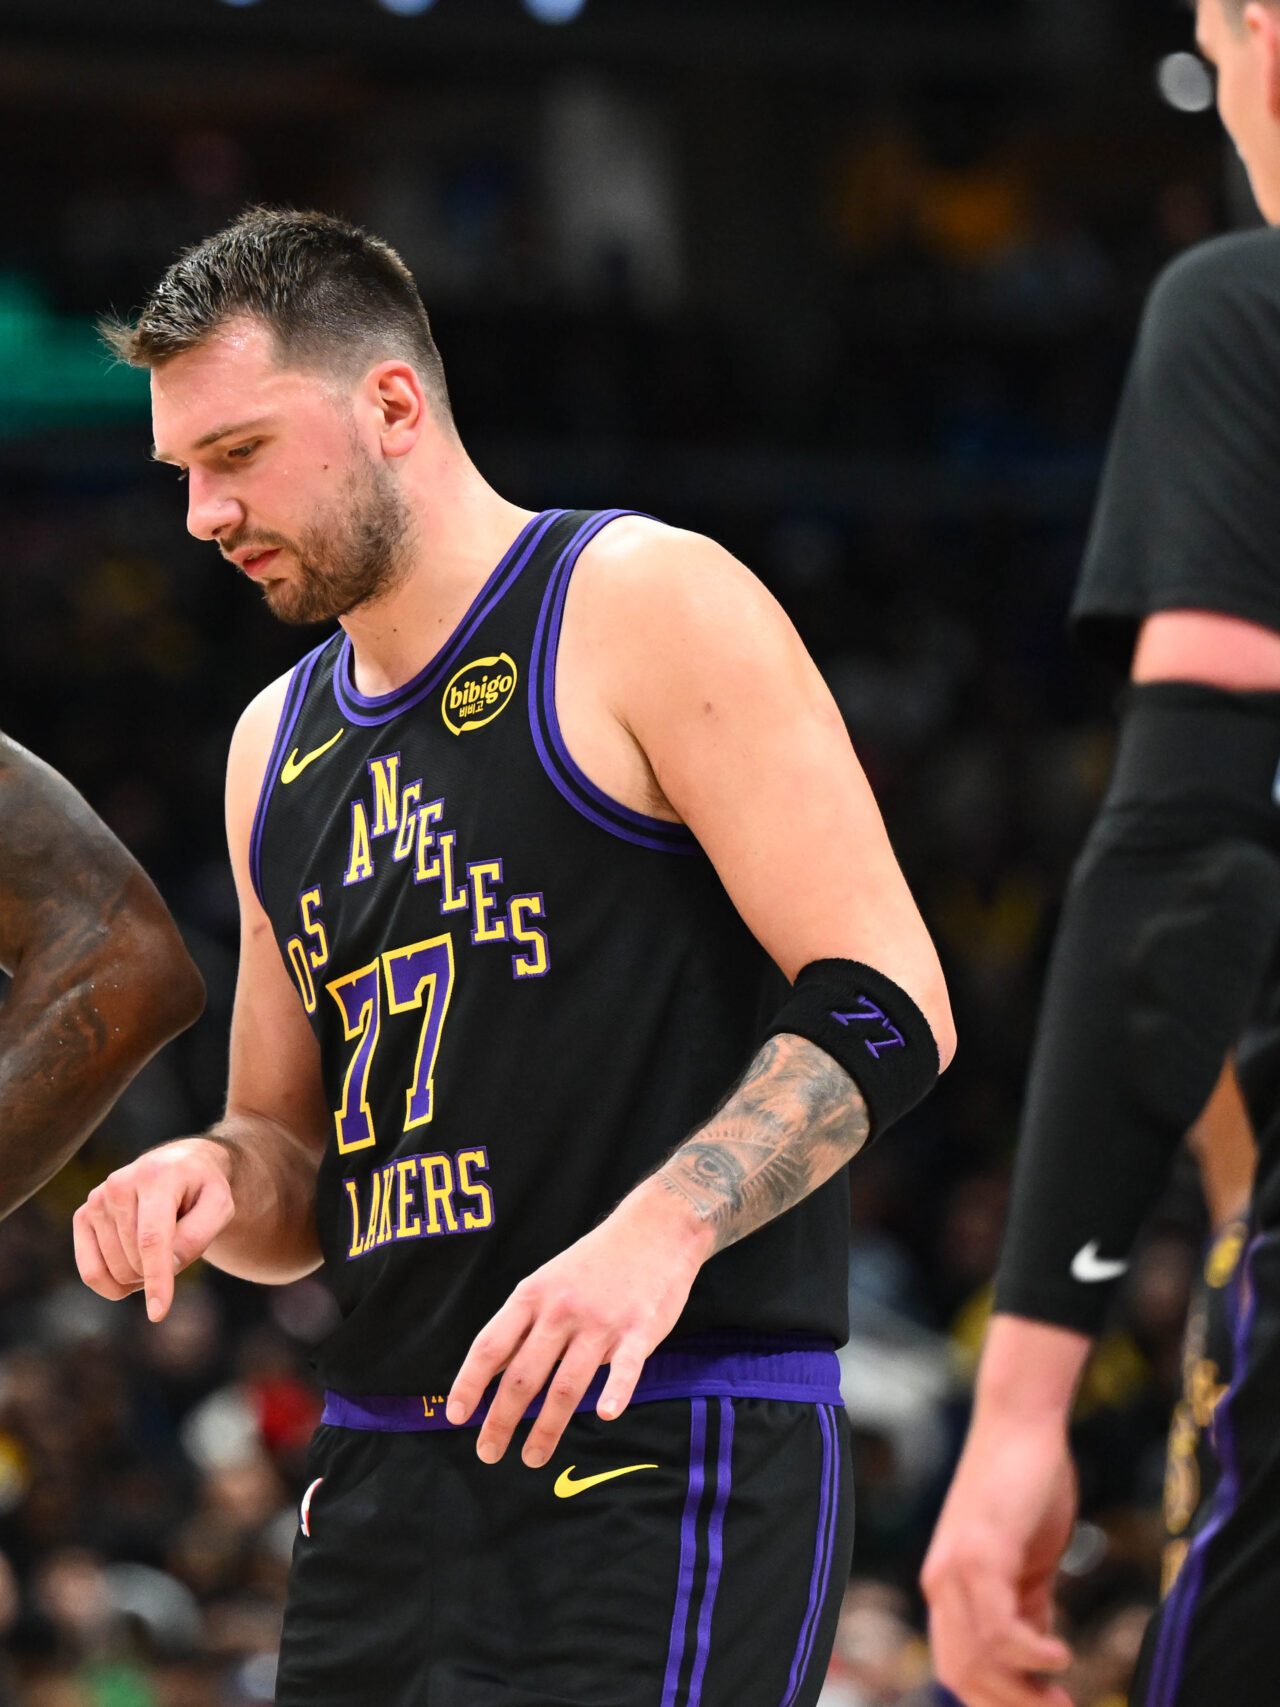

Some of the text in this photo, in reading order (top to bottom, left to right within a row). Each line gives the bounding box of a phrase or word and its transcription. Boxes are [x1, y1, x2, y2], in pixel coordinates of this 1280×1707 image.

[449, 674, 513, 710] bibigo
[458, 700, 484, 718] 비비고
[286, 751, 551, 1018] OS ANGELES
[325, 932, 455, 1156] 77
[830, 994, 906, 1059] 77
[342, 1145, 496, 1262] LAKERS
